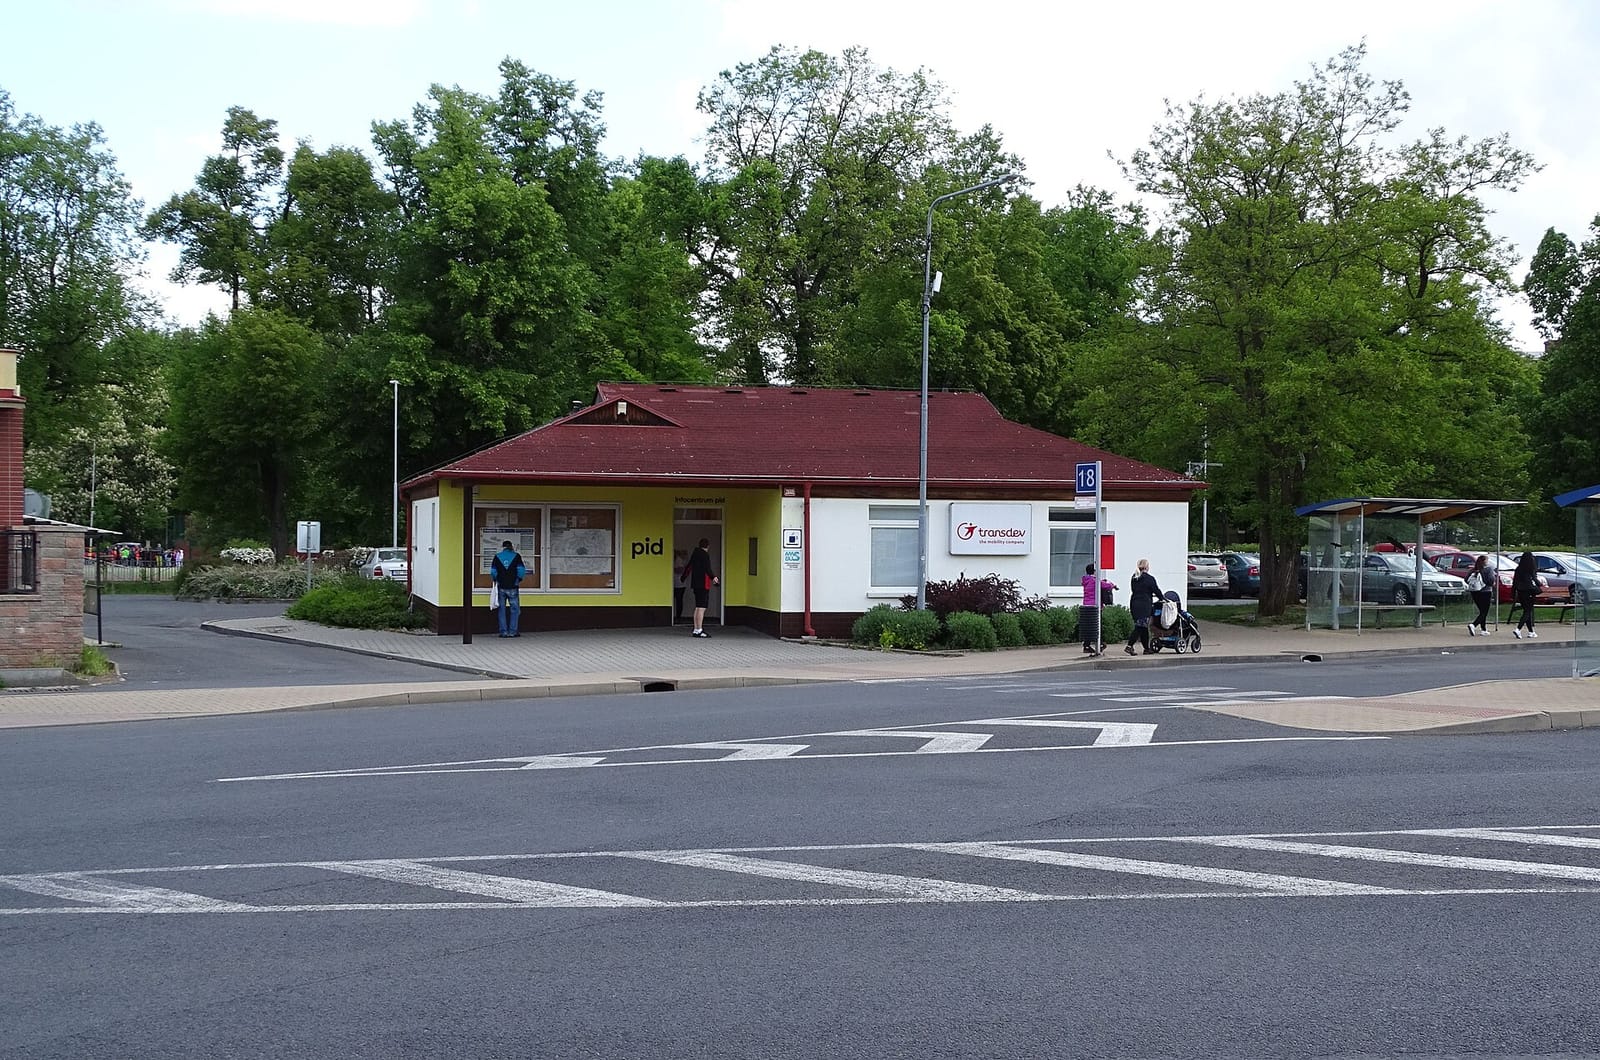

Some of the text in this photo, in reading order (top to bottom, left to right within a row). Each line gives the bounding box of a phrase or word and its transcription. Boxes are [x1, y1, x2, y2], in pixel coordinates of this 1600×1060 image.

[1078, 469, 1095, 487] 18
[978, 527, 1026, 537] transdev
[631, 537, 663, 559] pid
